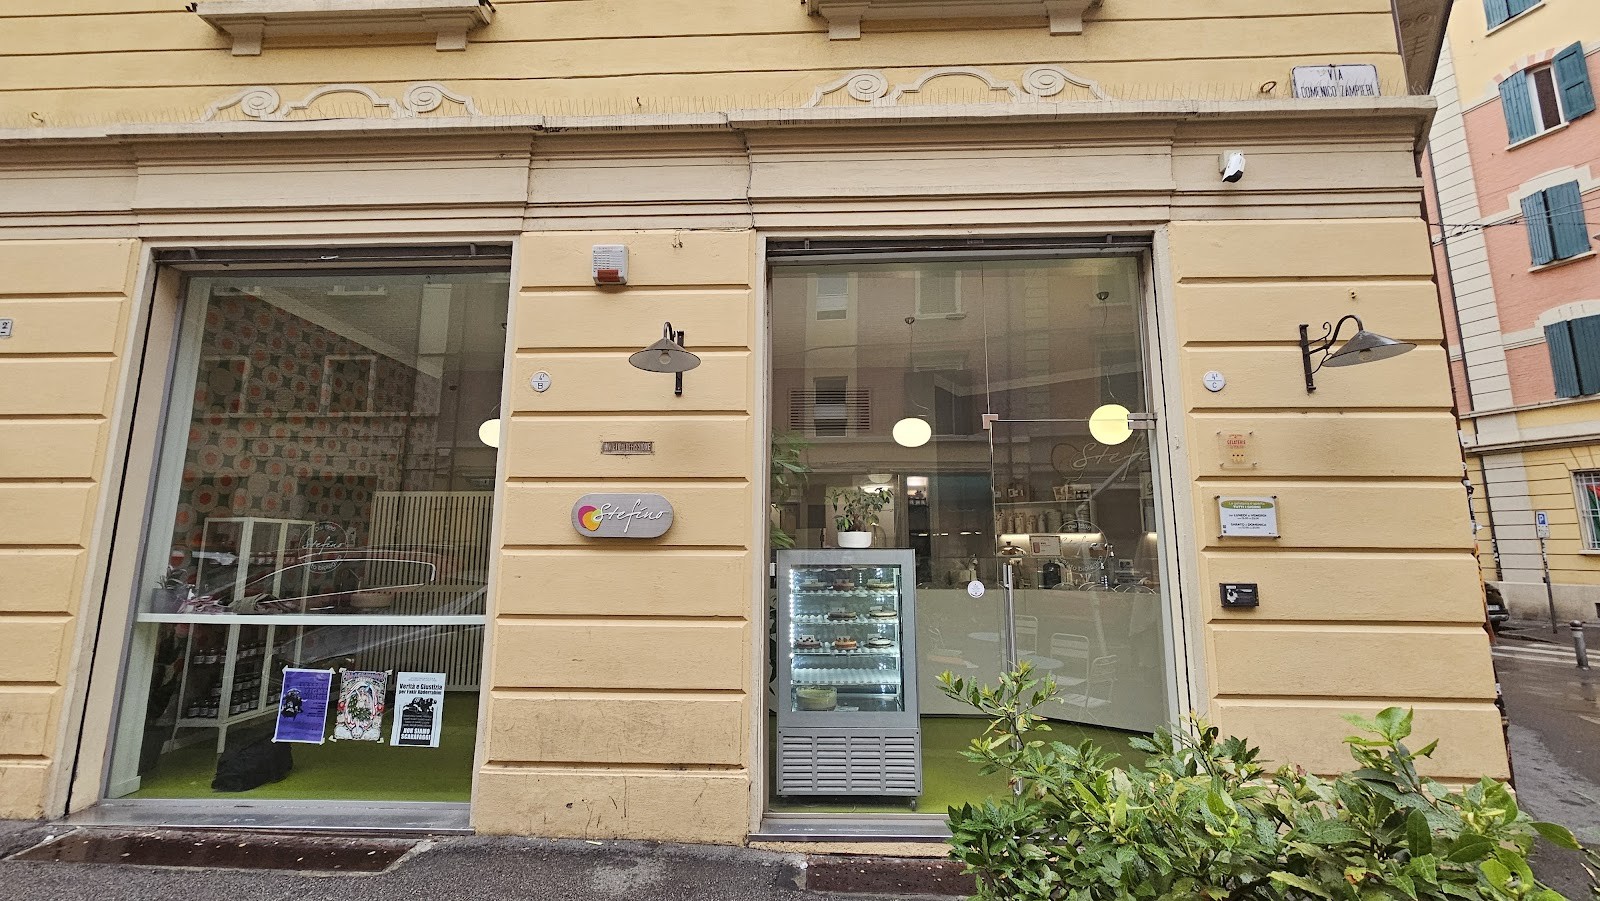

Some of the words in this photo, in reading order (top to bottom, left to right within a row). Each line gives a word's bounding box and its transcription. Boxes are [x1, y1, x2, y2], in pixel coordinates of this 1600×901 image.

[1328, 69, 1343, 80] VIA
[1301, 86, 1337, 98] DOMENICO
[1340, 84, 1374, 97] ZAMPIERI
[592, 499, 669, 533] Stefino
